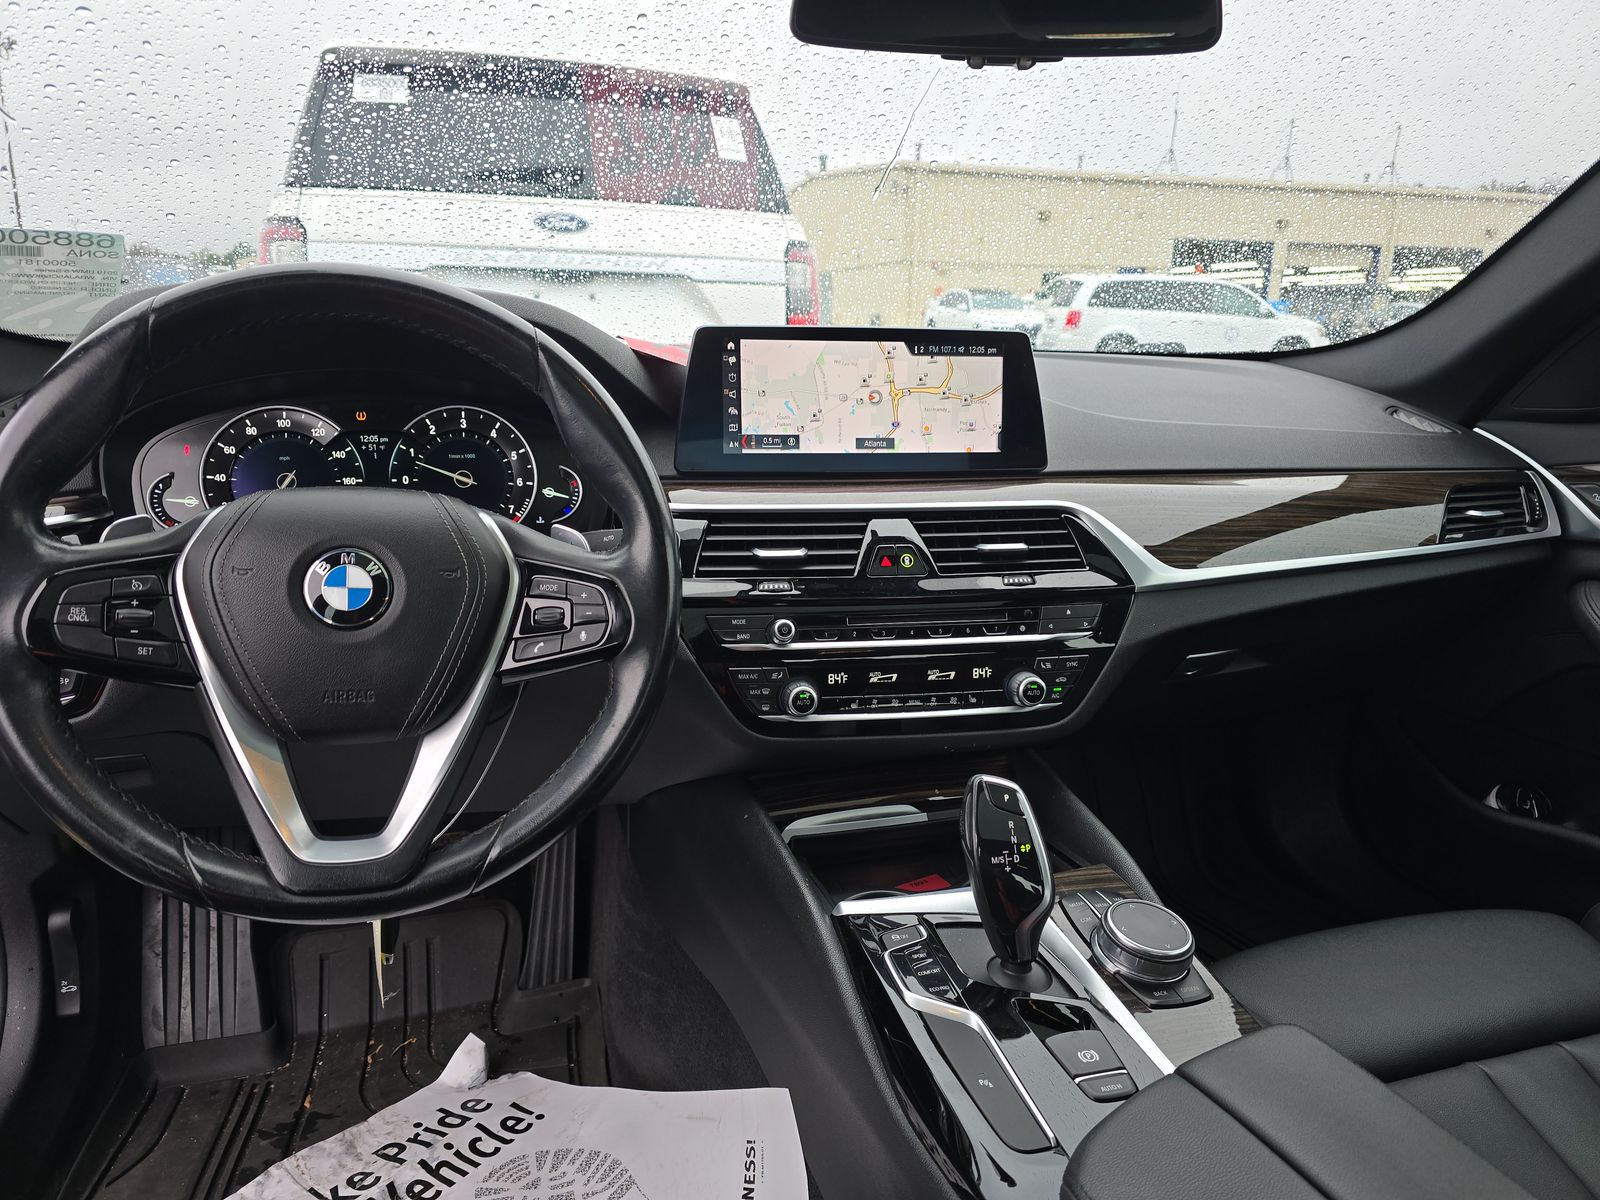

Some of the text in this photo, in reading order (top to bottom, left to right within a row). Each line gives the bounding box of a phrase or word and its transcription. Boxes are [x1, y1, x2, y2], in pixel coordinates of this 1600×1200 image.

[276, 419, 292, 428] 100
[460, 419, 467, 429] 3
[246, 427, 257, 436] 80
[310, 428, 325, 437] 120
[428, 425, 436, 435] 2
[490, 429, 497, 439] 4
[359, 435, 379, 443] 12:05
[223, 446, 236, 454] 60
[332, 450, 346, 459] 140
[409, 447, 415, 457] 1
[511, 450, 518, 460] 5
[214, 474, 226, 482] 40
[342, 477, 356, 486] 160
[402, 476, 409, 485] 0
[516, 478, 523, 487] 6
[508, 504, 515, 514] 7
[314, 552, 383, 577] BMW
[539, 584, 558, 592] MODE
[70, 607, 86, 615] RES
[67, 614, 89, 622] CNCL
[137, 647, 154, 656] SET
[972, 666, 993, 679] 84°F
[827, 672, 848, 685] 84°F
[322, 689, 376, 704] AIRBAG
[1003, 793, 1010, 802] P
[1008, 820, 1015, 829] R
[1011, 835, 1018, 844] N
[991, 855, 1020, 864] M/S D
[917, 967, 941, 976] COMFORT
[1100, 1085, 1117, 1093] AUTO
[371, 1098, 493, 1165] Pride
